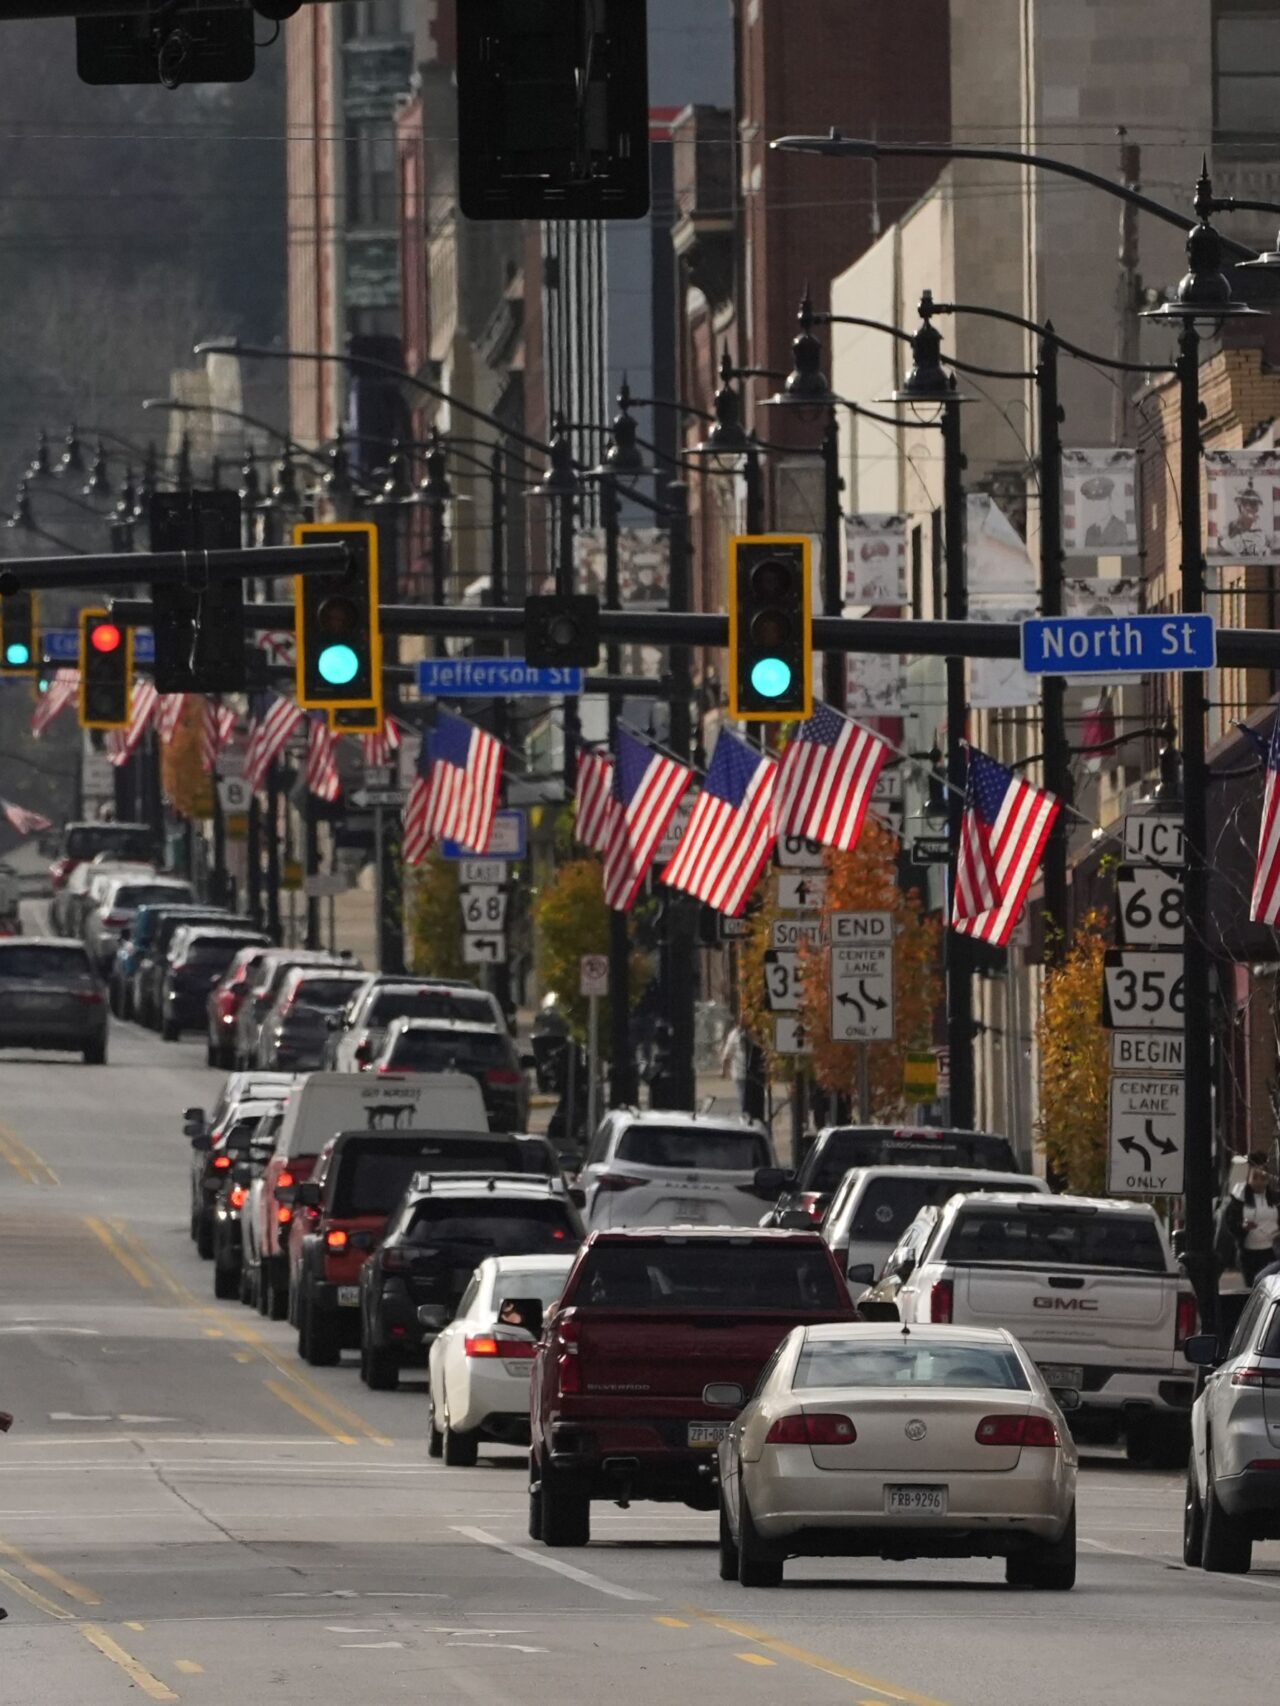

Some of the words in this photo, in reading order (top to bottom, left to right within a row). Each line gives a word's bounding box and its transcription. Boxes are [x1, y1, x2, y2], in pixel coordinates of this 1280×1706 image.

[1042, 622, 1142, 659] North
[1161, 622, 1193, 655] St
[429, 662, 539, 687] Jefferson
[549, 666, 571, 685] St
[1127, 822, 1184, 856] JCT
[468, 897, 501, 922] 68
[1125, 887, 1184, 929] 68
[838, 919, 885, 937] END
[839, 951, 885, 961] CENTER
[846, 963, 878, 973] LANE
[846, 1026, 879, 1036] ONLY
[1120, 1040, 1182, 1064] BEGIN
[1120, 1082, 1180, 1096] CENTER
[1129, 1099, 1169, 1111] LANE
[1126, 1176, 1168, 1189] ONLY
[1033, 1296, 1099, 1311] GMC
